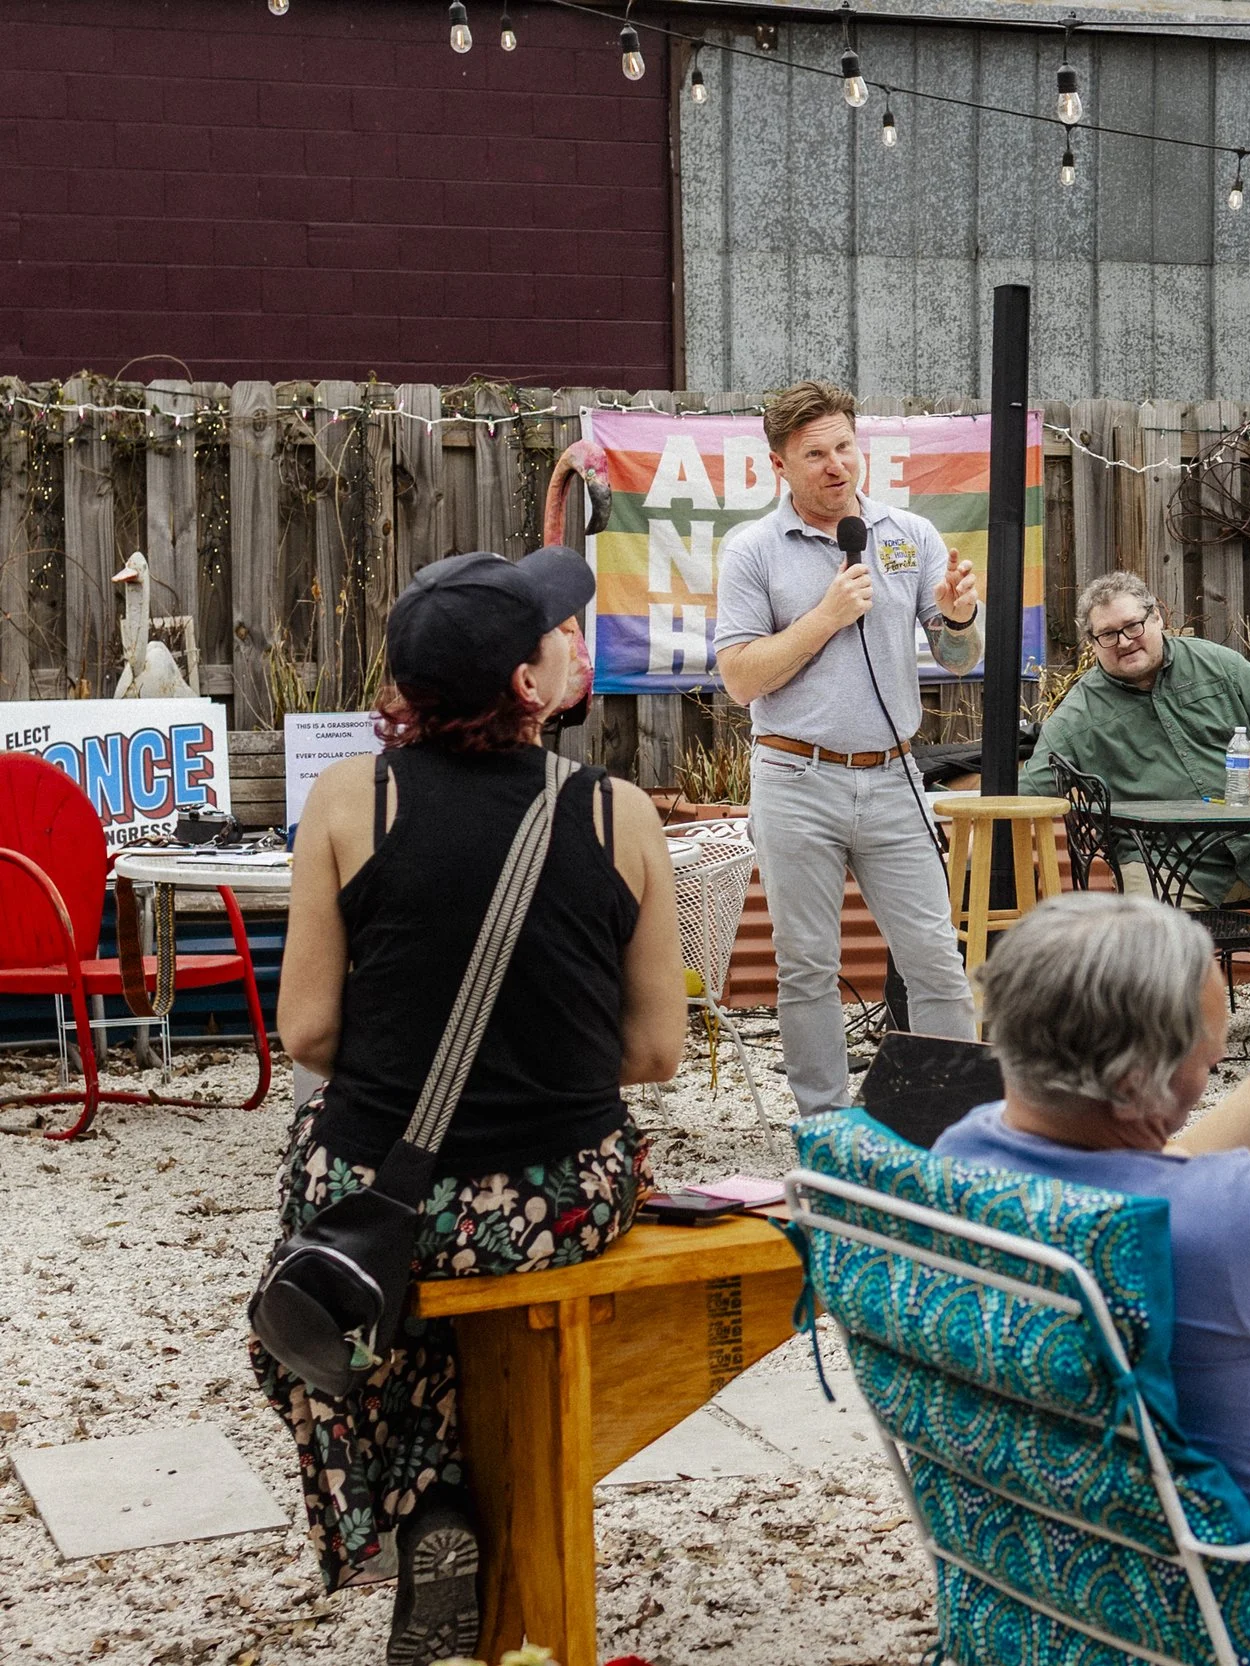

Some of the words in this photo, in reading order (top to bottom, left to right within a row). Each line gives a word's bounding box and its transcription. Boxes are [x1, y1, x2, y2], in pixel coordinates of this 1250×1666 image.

[641, 434, 911, 510] ABE
[884, 556, 917, 573] Florida
[6, 725, 51, 750] ELECT
[315, 731, 354, 739] CAMPAIGN.
[326, 721, 373, 729] GRASSROOTS
[24, 722, 218, 826] ONCE
[105, 822, 173, 847] NGRESS
